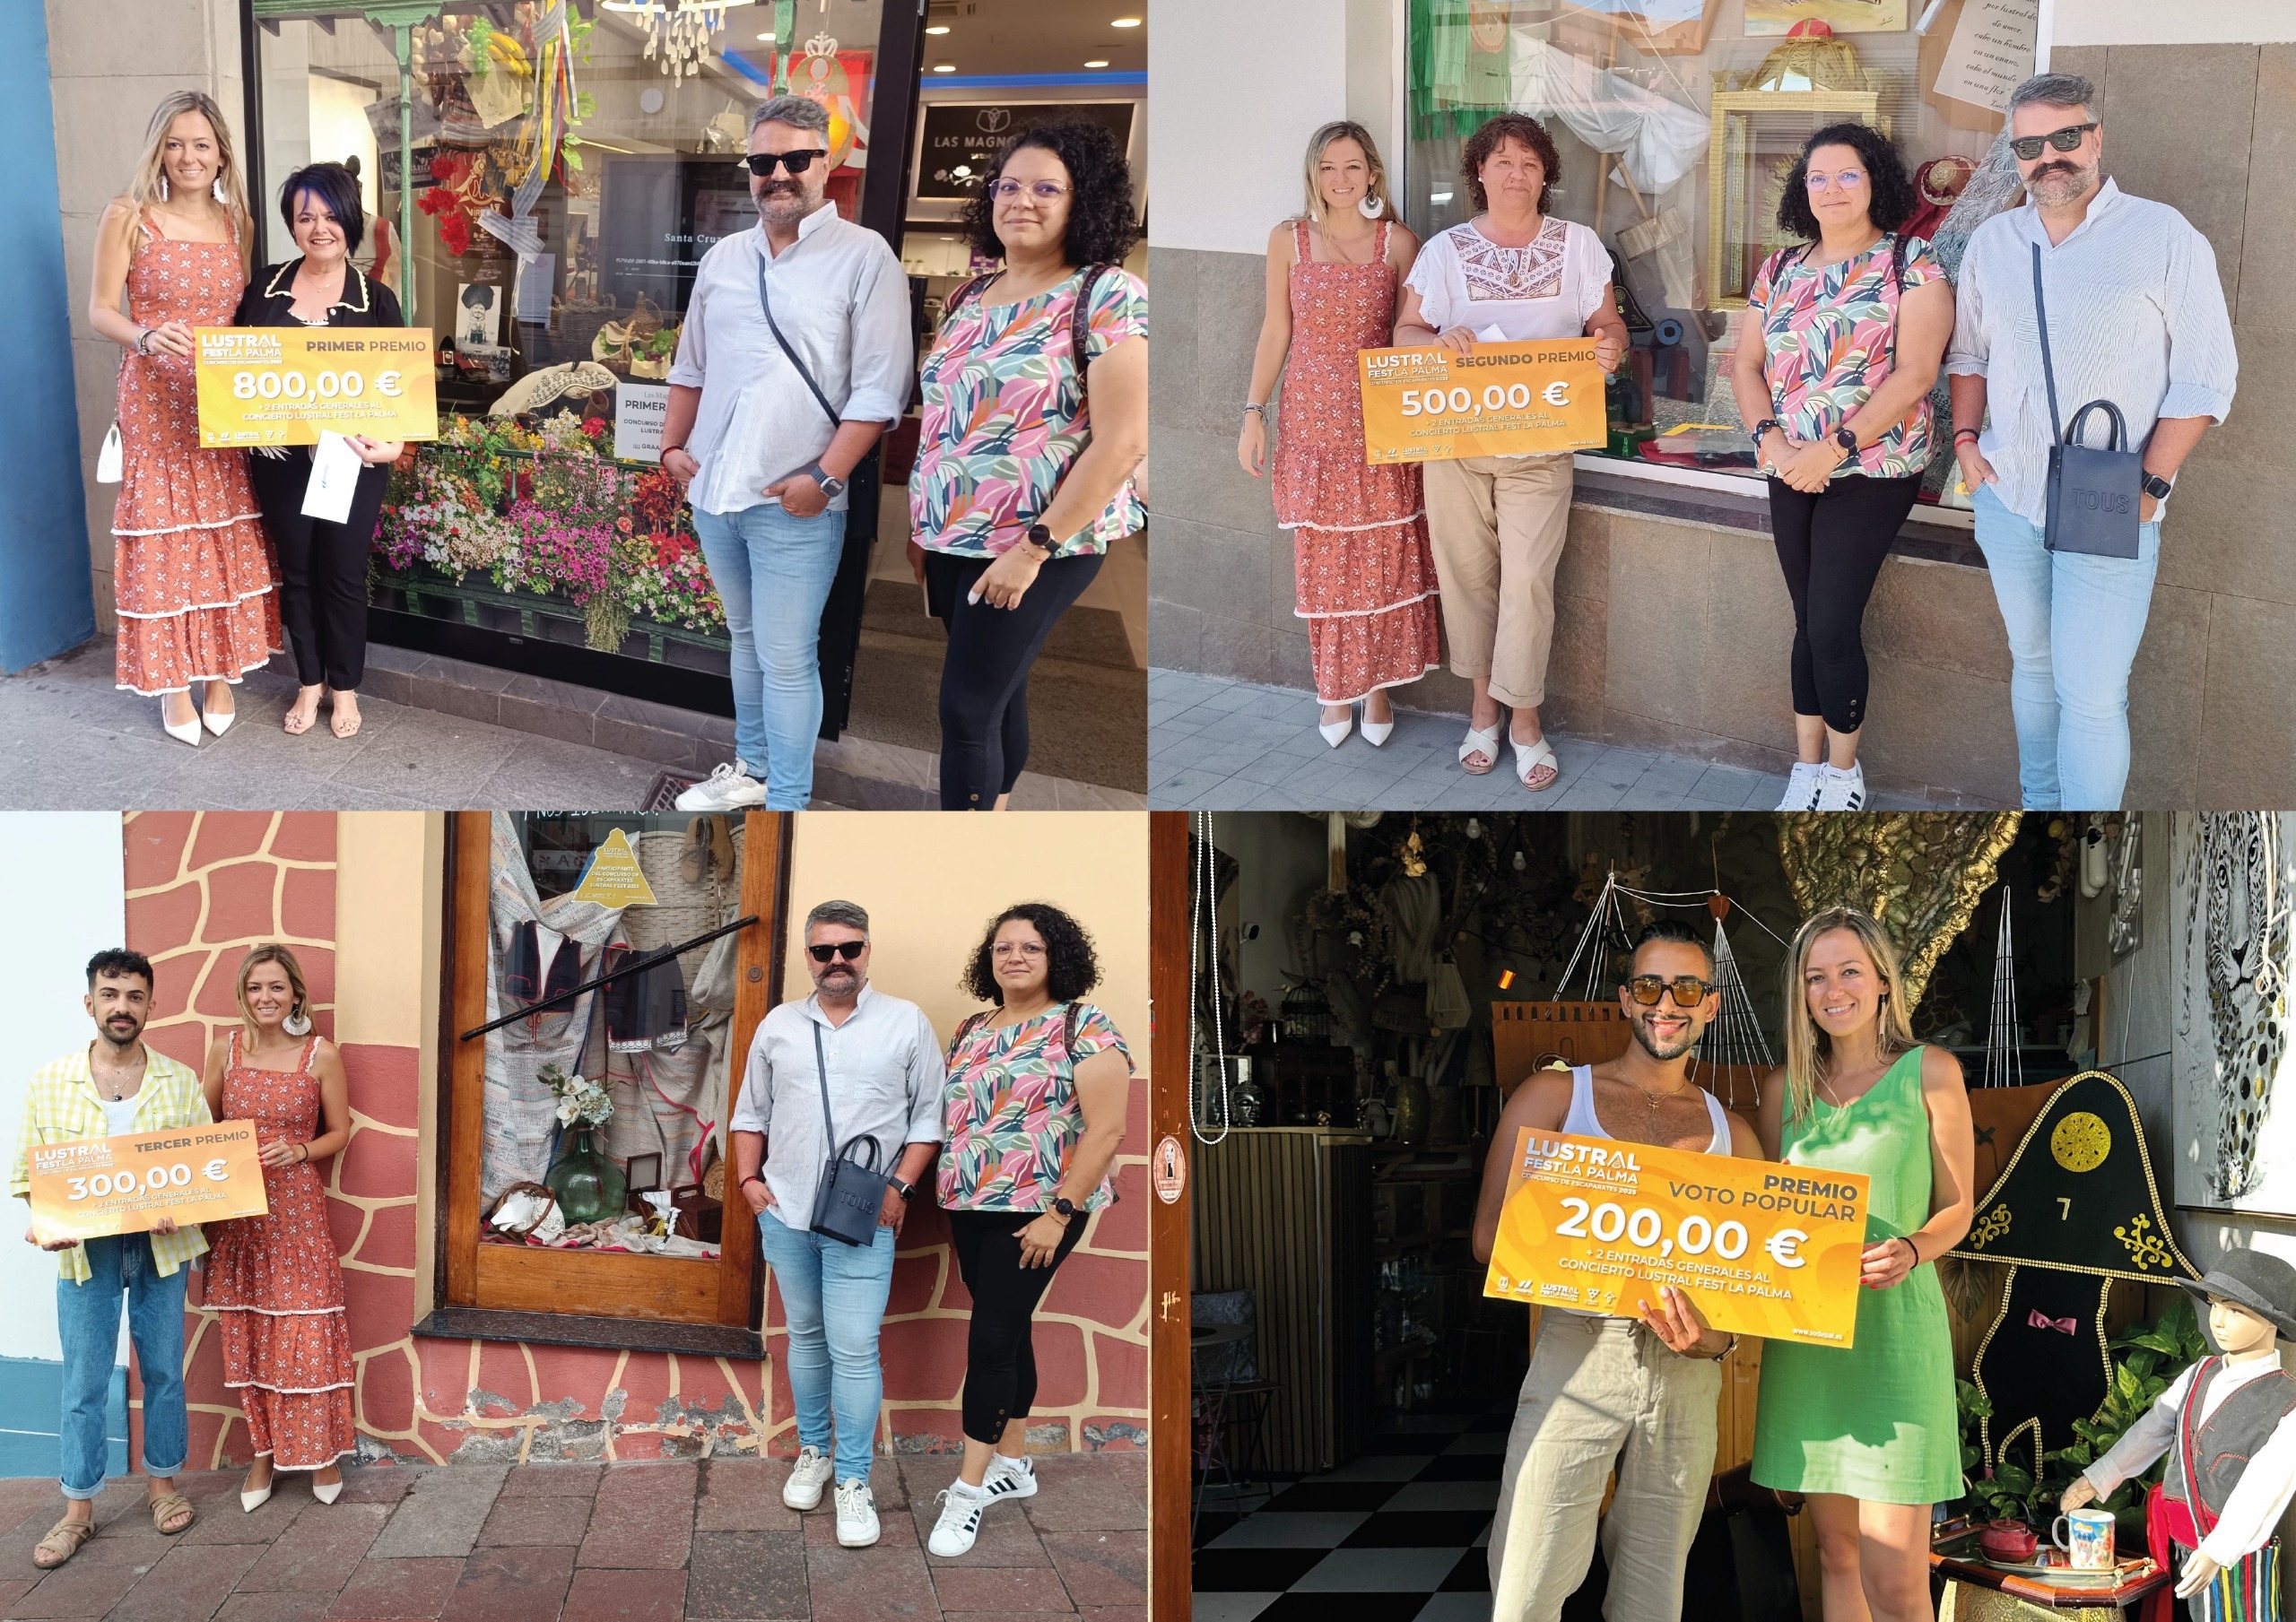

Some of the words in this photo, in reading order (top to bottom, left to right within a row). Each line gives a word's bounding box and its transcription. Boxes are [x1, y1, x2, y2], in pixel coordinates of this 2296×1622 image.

[935, 136, 959, 147] LAS
[665, 233, 692, 243] Santa
[697, 234, 721, 244] Cruz
[1618, 306, 1624, 314] 3
[202, 334, 282, 348] LUSTRAL
[307, 341, 364, 351] PRIMER
[370, 341, 426, 351] PREMIO
[246, 349, 282, 357] PALMA
[1367, 352, 1448, 369] LUSTRAL
[1456, 353, 1533, 369] SEGUNDO
[1538, 351, 1596, 363] PREMIO
[1412, 366, 1448, 375] PALMA
[233, 370, 364, 403] 800,00
[375, 370, 403, 397] €
[656, 392, 669, 401] Mag
[1401, 383, 1530, 416] 500,00
[1542, 381, 1570, 406] €
[625, 400, 665, 412] PRIMER
[1439, 417, 1485, 426] ENTRADAS
[1487, 413, 1536, 422] GENERALES
[1409, 427, 1460, 437] CONCIERTO
[1462, 425, 1500, 434] LUSTRAL
[1501, 422, 1522, 430] FEST
[1536, 420, 1565, 428] PALMA
[2073, 488, 2129, 515] TOUS
[135, 1138, 192, 1152] TERCER
[196, 1131, 249, 1146] PREMIO
[35, 1143, 112, 1162] LUSTRAL
[79, 1154, 113, 1165] PALMA
[1526, 1138, 1641, 1171] LUSTRAL
[67, 1164, 192, 1201] 300,00
[202, 1158, 230, 1182] €
[1521, 1173, 1560, 1184] CONCURSO
[1571, 1180, 1618, 1193] ESCAPARATES
[1619, 1187, 1637, 1195] 2025
[1587, 1167, 1639, 1184] PALMA
[1763, 1175, 1857, 1201] PREMIO
[77, 1206, 126, 1218] CONCIERTO
[128, 1201, 164, 1212] LUSTRAL
[166, 1198, 186, 1207] FEST
[198, 1193, 227, 1202] PALMA
[105, 1194, 151, 1206] ENTRADAS
[152, 1189, 199, 1200] GENERALES
[841, 1189, 875, 1215] TOUS
[1669, 1181, 1735, 1205] VOTO
[1742, 1191, 1856, 1222] POPULAR
[2057, 1197, 2071, 1220] 7
[1555, 1197, 1749, 1260] 200,00
[1764, 1228, 1810, 1269] €
[1596, 1249, 1604, 1260] 2
[1606, 1252, 1674, 1270] ENTRADAS
[1677, 1261, 1752, 1280] GENERALES
[1753, 1271, 1770, 1283] AL
[1559, 1258, 1635, 1279] CONCIERTO
[1638, 1269, 1692, 1287] LUSTRAL
[1695, 1279, 1726, 1291] FEST
[1728, 1283, 1745, 1294] LA
[1747, 1286, 1792, 1300] PALMA
[1541, 1283, 1579, 1295] LUSTRAL
[1793, 1328, 1843, 1340] www.sodepal.es
